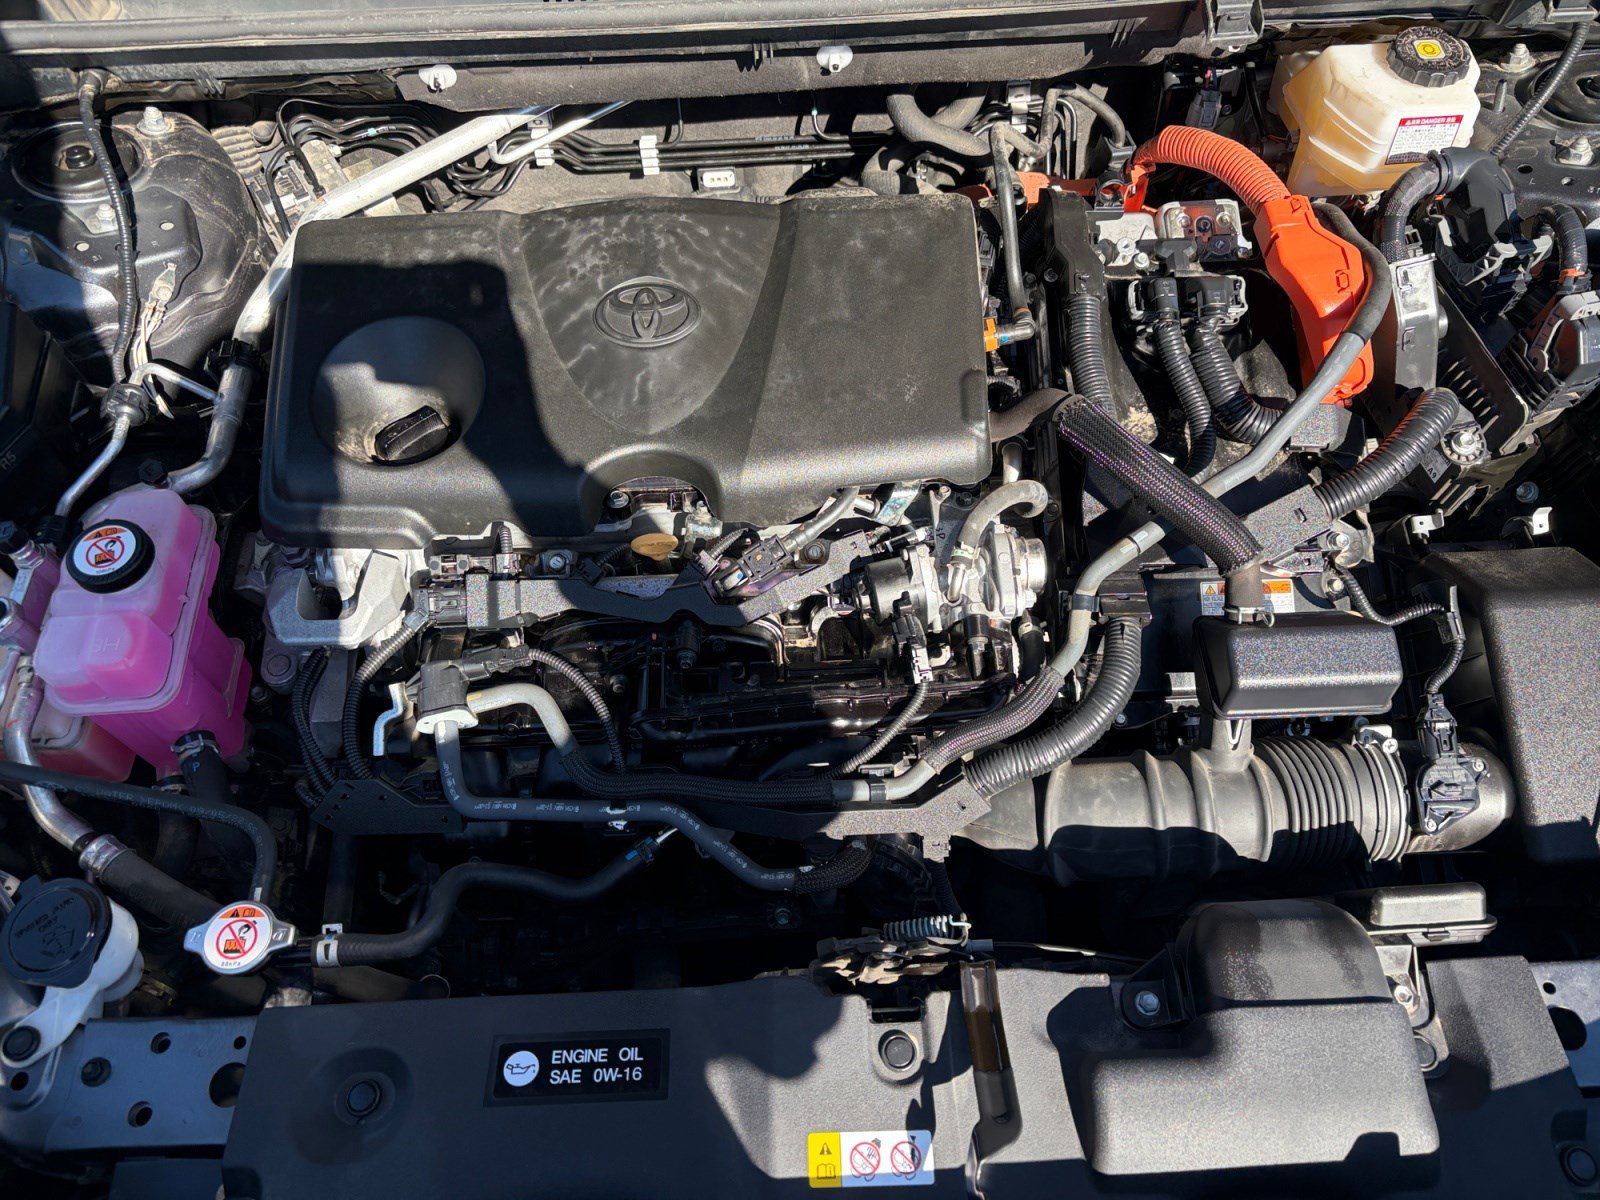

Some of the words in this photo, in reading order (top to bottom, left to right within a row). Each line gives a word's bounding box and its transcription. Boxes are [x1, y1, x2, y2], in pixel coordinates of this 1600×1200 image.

[551, 1048, 609, 1065] ENGINE
[618, 1047, 644, 1062] OIL
[549, 1069, 582, 1085] SAE
[593, 1067, 642, 1083] 0W-16
